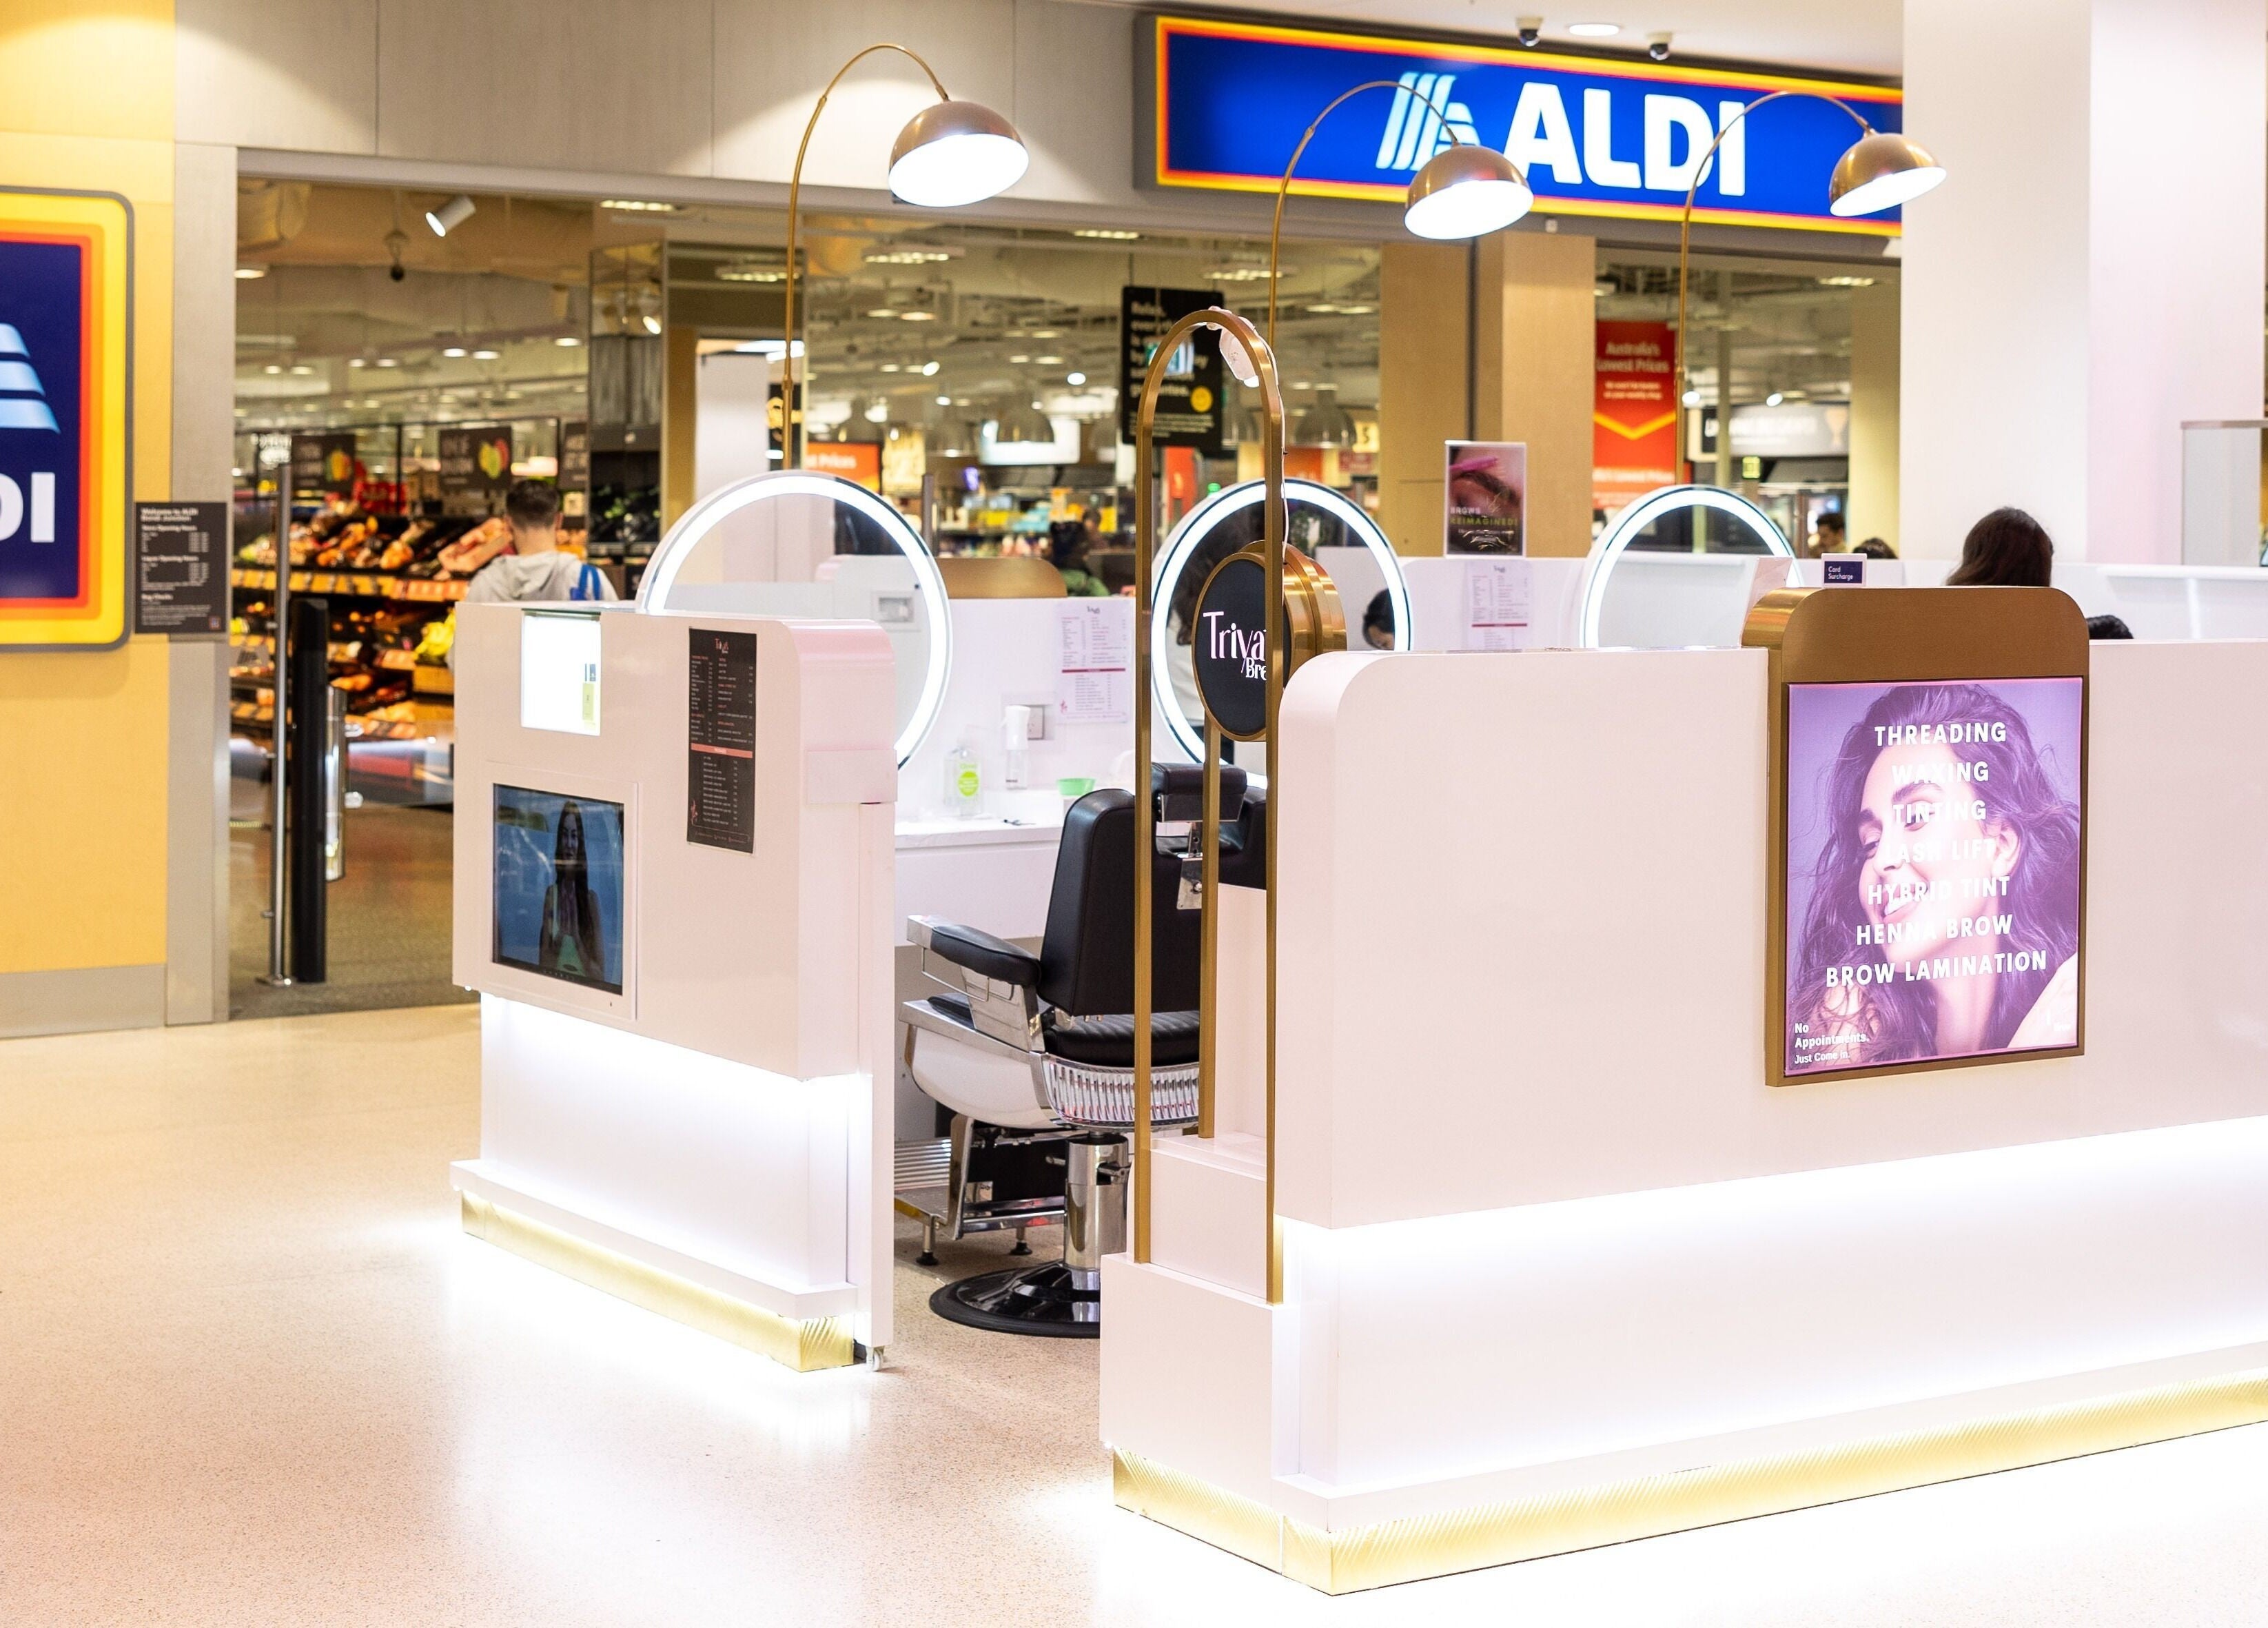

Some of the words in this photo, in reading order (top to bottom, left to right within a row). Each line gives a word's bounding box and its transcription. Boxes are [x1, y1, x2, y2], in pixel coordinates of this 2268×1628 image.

[1503, 81, 1745, 196] ALDI
[1203, 611, 1267, 673] Triya
[1874, 722, 2006, 746] THREADING
[1891, 760, 1989, 786] WAXING
[1892, 800, 1986, 824] TINTING
[1885, 841, 1941, 864] LASH
[1952, 837, 1996, 861] LIFT
[1867, 879, 1952, 905] HYBRID
[1961, 875, 2010, 899] TINT
[1856, 921, 1937, 946] HENNA
[1946, 914, 2013, 939] BROW
[1826, 962, 1895, 988] BROW
[1905, 950, 2046, 982] LAMINATION
[1795, 1022, 1810, 1034] No
[1795, 1033, 1870, 1050] Appointments.
[1794, 1054, 1812, 1065] Just
[1813, 1052, 1838, 1062] Come
